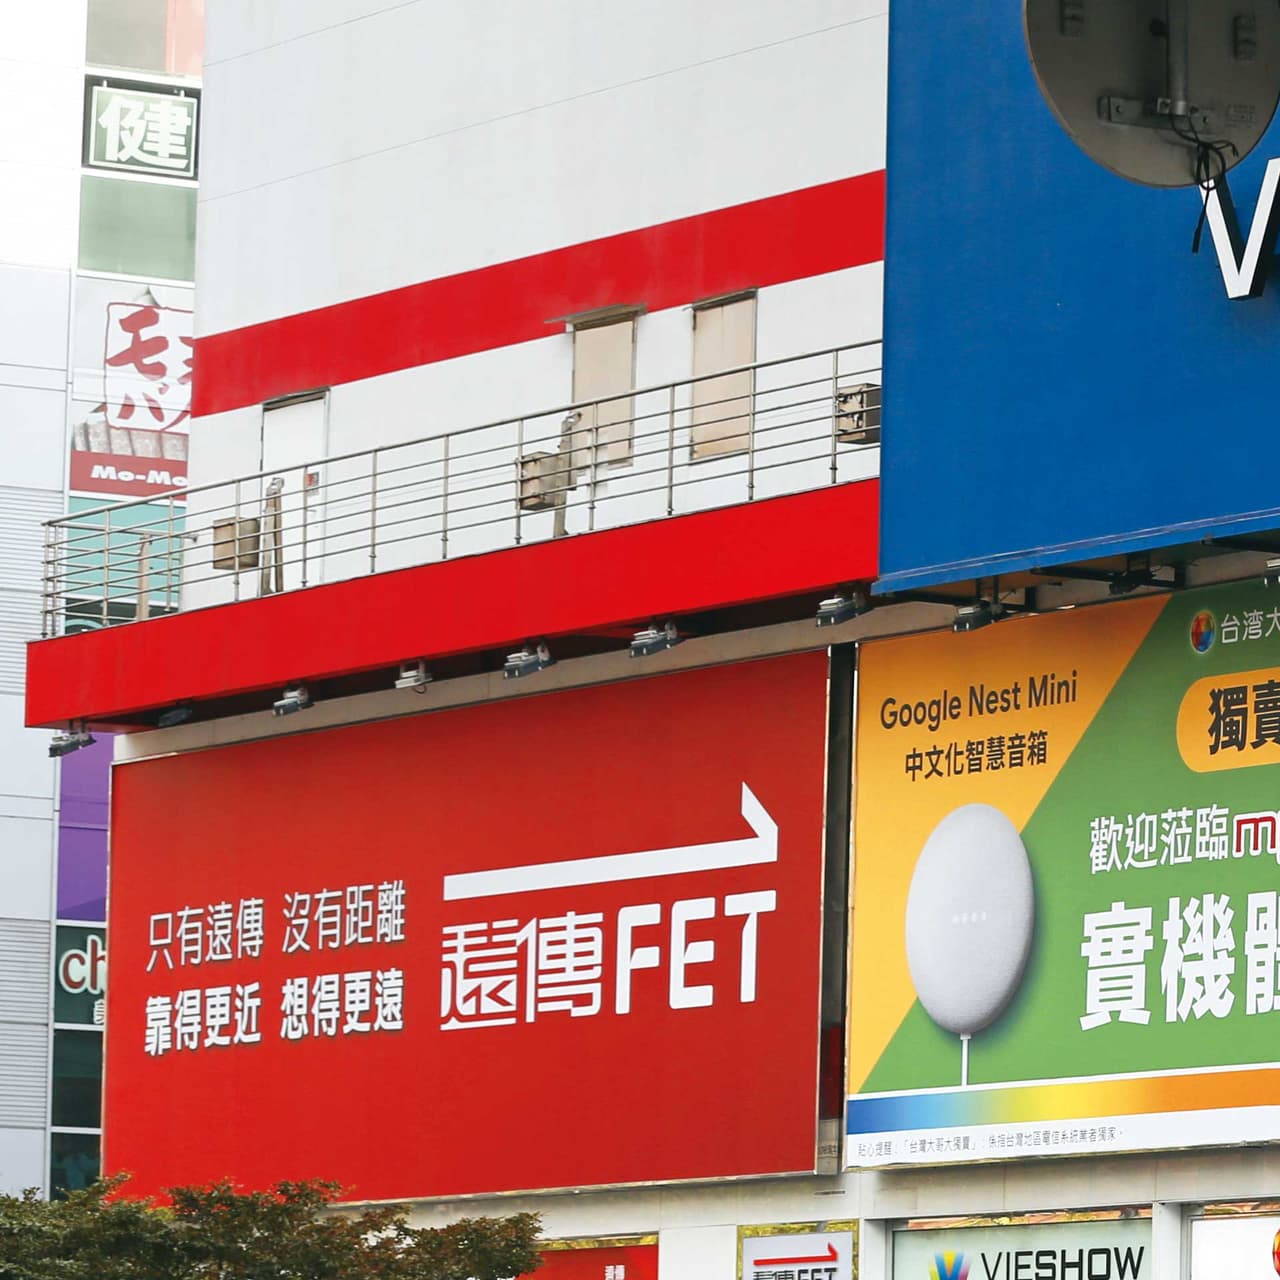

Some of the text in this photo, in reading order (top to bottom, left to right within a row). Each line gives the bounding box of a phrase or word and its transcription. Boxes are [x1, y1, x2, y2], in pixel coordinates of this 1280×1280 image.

[97, 95, 192, 167] 健
[879, 669, 1078, 735] Google Nest Mini
[904, 729, 1050, 783] 中文化智慧音箱
[147, 880, 407, 973] 只有遠傳 沒有距離
[144, 967, 406, 1057] 靠得更近 想得更遠
